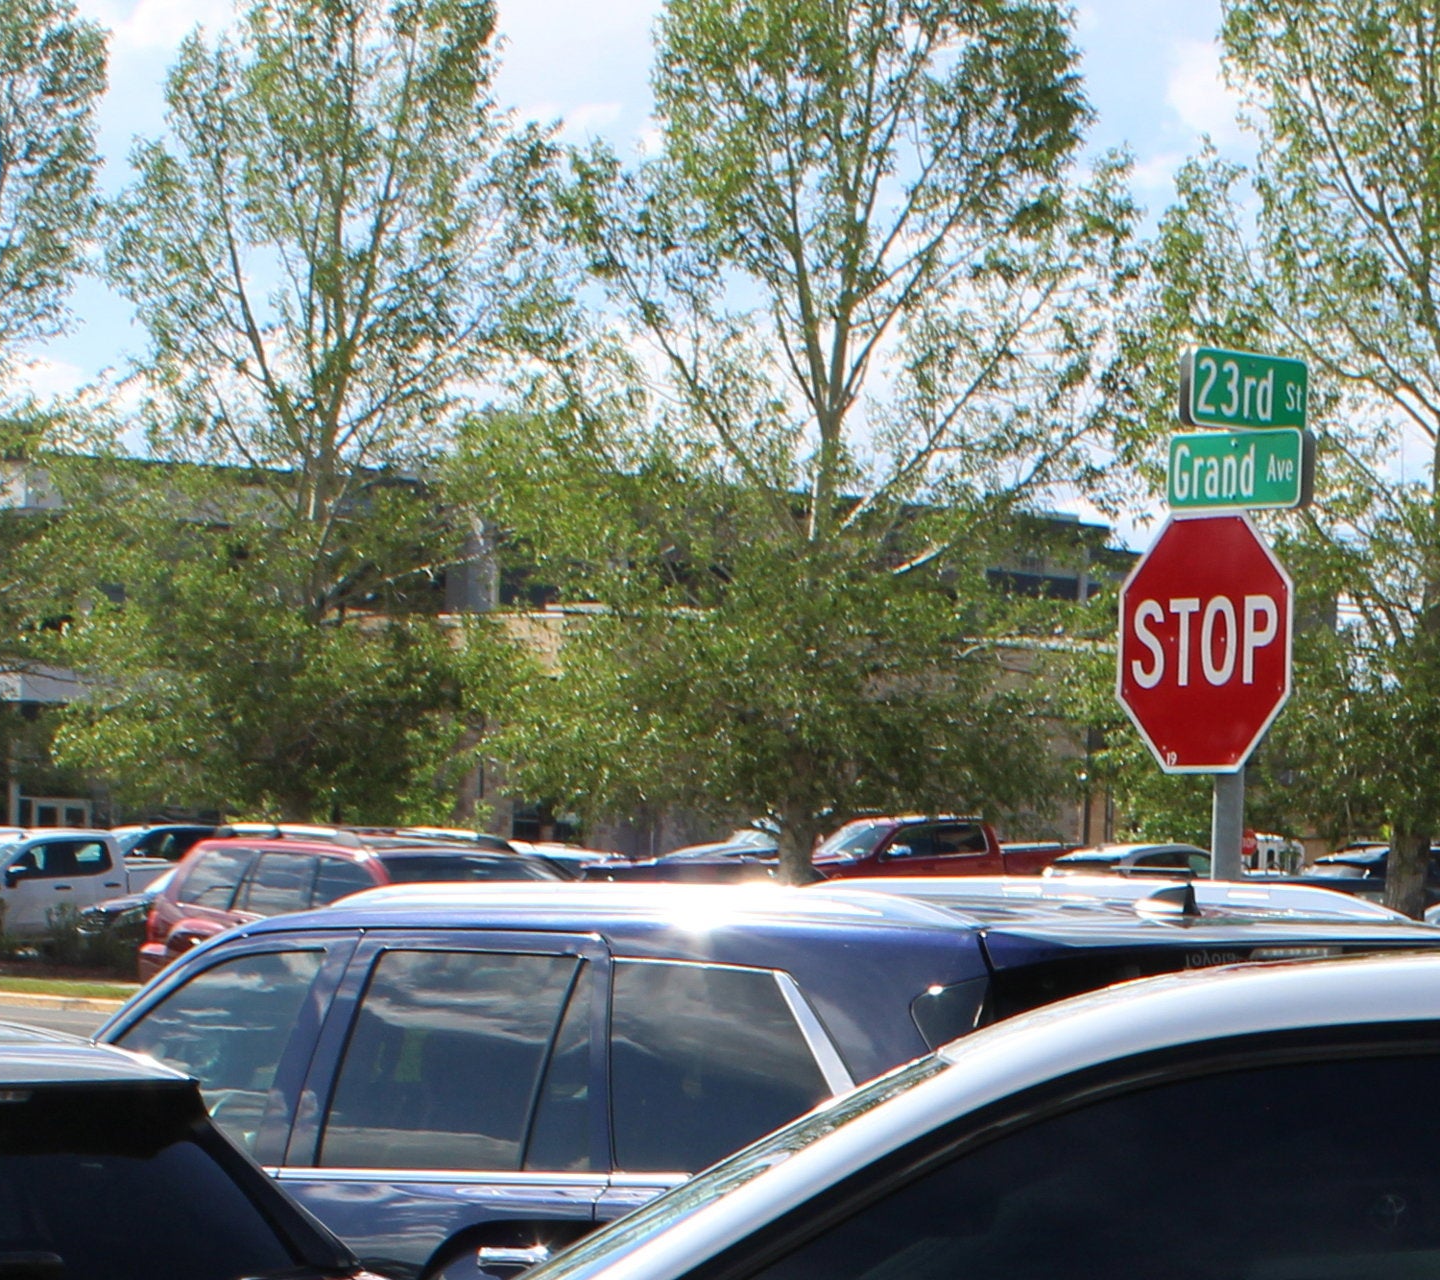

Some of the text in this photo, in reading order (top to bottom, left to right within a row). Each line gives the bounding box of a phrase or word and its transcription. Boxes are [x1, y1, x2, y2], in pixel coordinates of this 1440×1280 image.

[1197, 357, 1303, 422] 23rd St
[1173, 444, 1294, 500] Grand Ave
[1131, 594, 1279, 689] STOP
